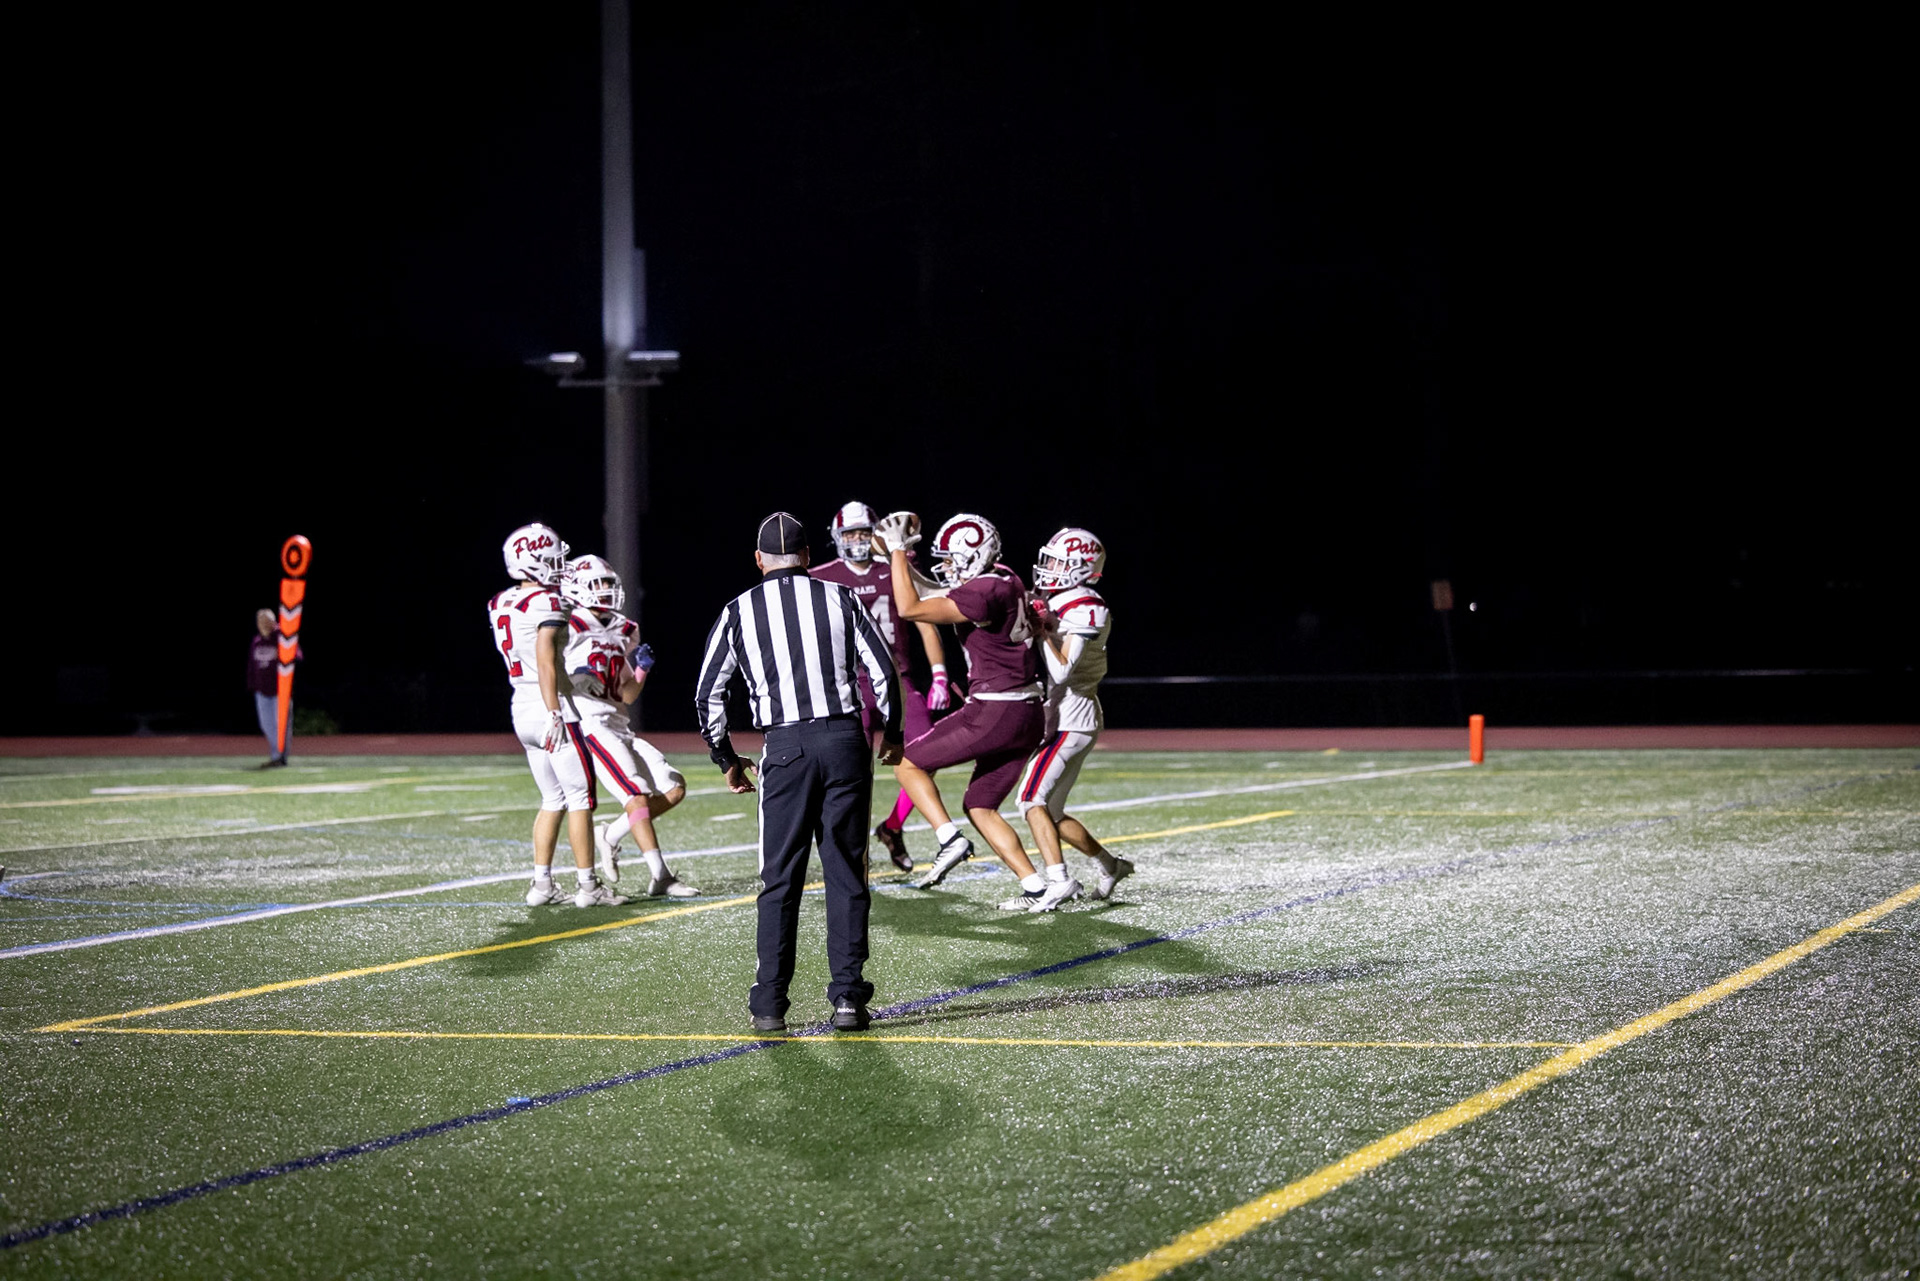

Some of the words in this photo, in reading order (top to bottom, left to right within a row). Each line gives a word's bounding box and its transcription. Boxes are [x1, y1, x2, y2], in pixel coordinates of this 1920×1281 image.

[513, 535, 554, 559] Pats
[1089, 609, 1096, 627] 1
[498, 614, 523, 677] 2
